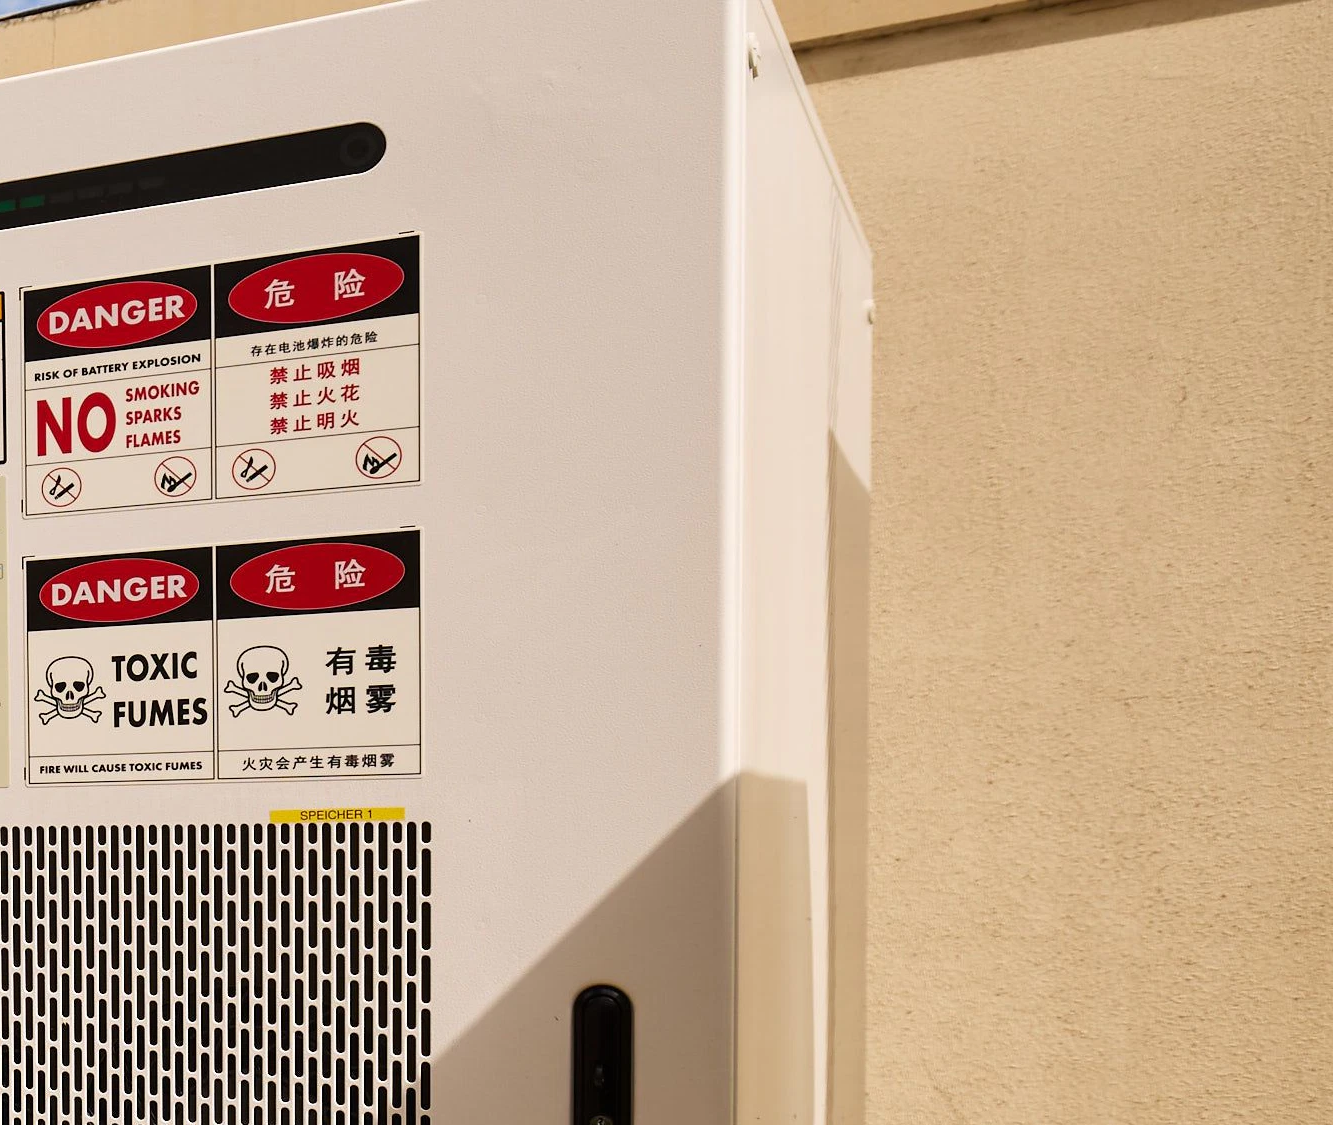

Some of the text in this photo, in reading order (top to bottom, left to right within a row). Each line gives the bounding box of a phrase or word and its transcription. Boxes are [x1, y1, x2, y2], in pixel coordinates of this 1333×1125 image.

[264, 268, 366, 310] 危险
[48, 294, 186, 336] DANGER
[250, 331, 378, 357] 存在电池爆炸的危险
[34, 353, 202, 382] RISK OF BATTERY EXPLOSION
[270, 358, 361, 385] 禁止吸烟
[125, 380, 200, 403] SMOKING
[270, 383, 361, 410] 禁止火花
[36, 391, 116, 457] NO
[125, 406, 182, 427] SPARKS
[270, 409, 360, 435] 禁止明火
[125, 429, 182, 449] FLAMES
[51, 574, 188, 607] DANGER
[265, 558, 367, 595] 危险
[111, 651, 198, 682] TOXIC
[325, 644, 397, 676] 有毒
[113, 697, 208, 728] FUMES
[325, 684, 396, 716] 烟雾
[39, 761, 203, 774] FIRE WILL CAUSE TOXIC FUMES
[242, 753, 395, 771] 火灾会产生有毒烟雾
[300, 809, 373, 821] SPEICHER 1
